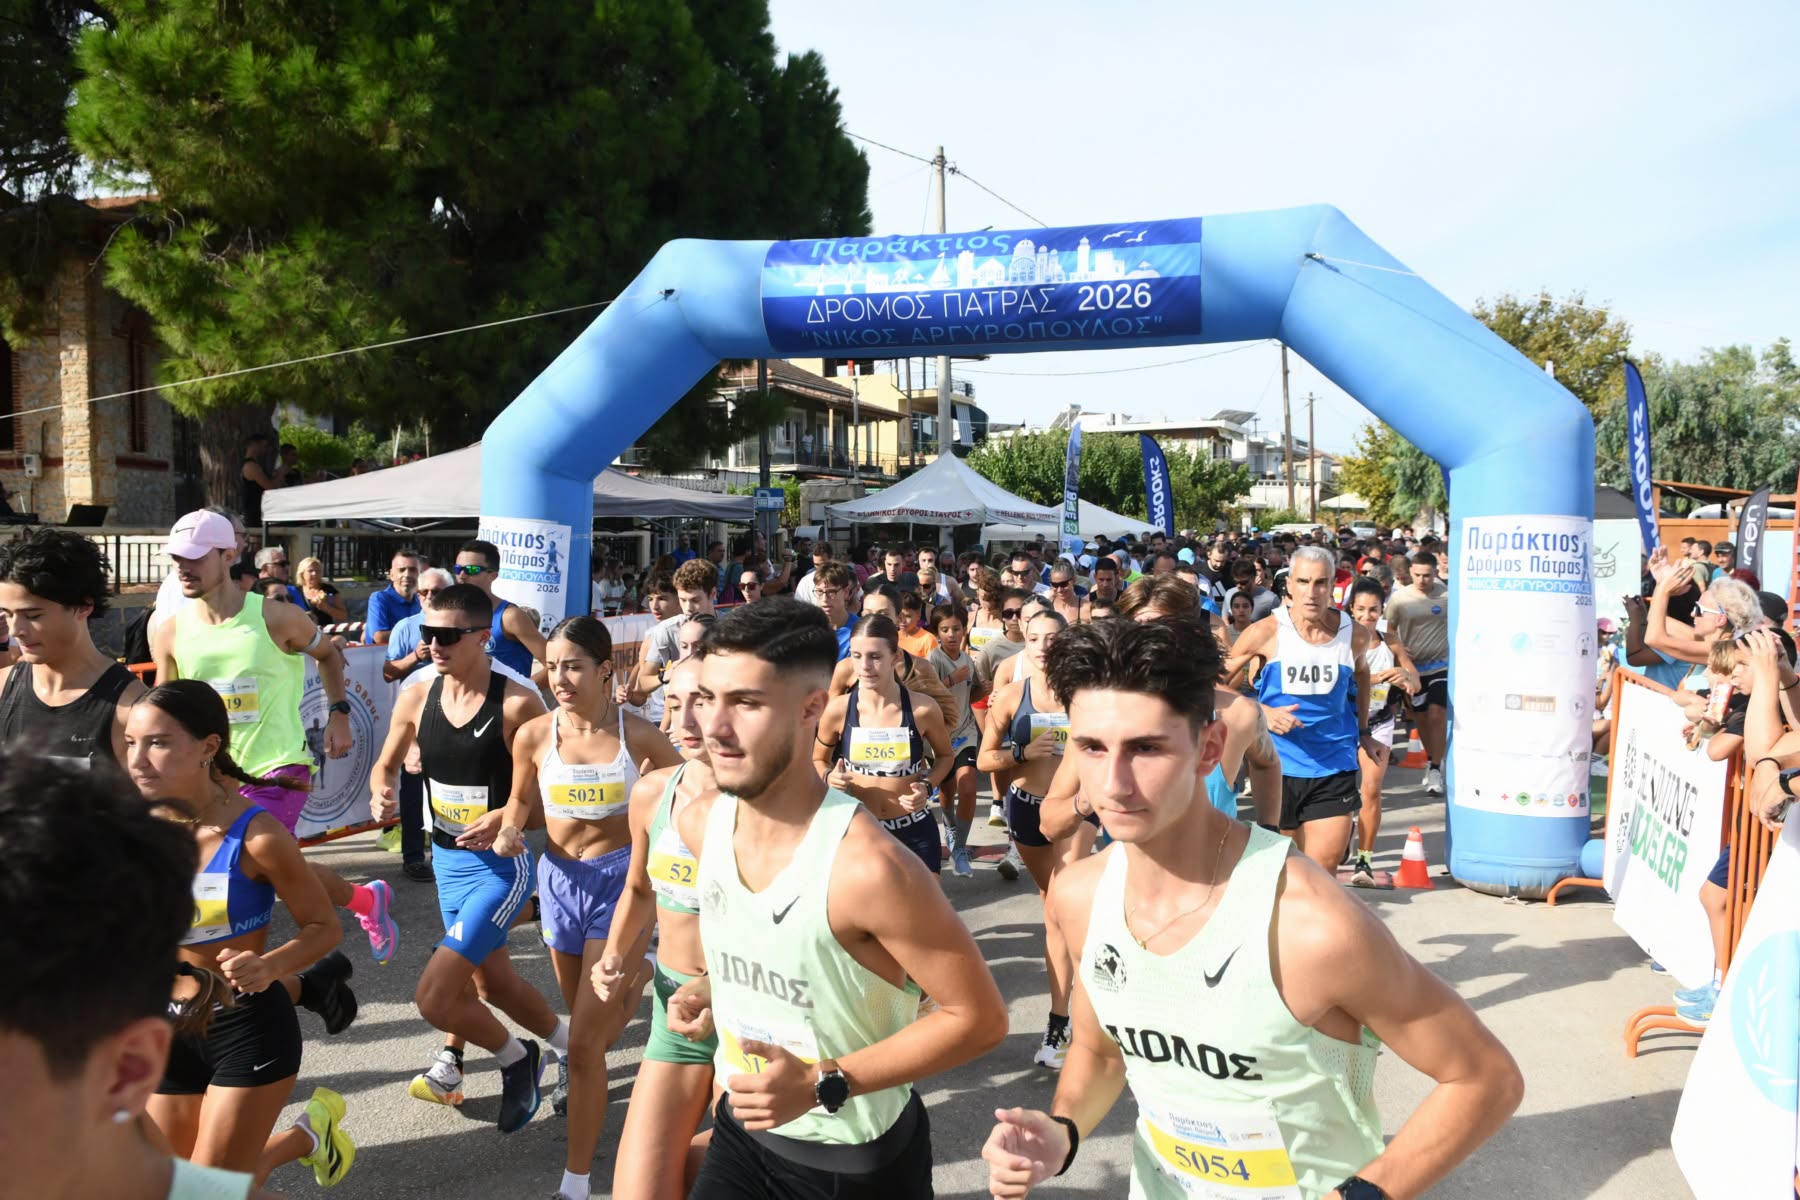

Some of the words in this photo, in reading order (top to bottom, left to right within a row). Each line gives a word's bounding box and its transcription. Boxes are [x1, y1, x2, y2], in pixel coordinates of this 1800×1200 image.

[811, 234, 1012, 260] Παράκτιος
[807, 294, 933, 324] ΔΡΟΜΟΣ
[943, 287, 1057, 319] ΠΑΤΡΑΣ
[1078, 282, 1152, 312] 2026
[1468, 526, 1579, 555] Παράκτιος
[502, 549, 545, 568] Πάτρας
[1467, 555, 1522, 575] Δρόμος
[1530, 555, 1581, 577] Πάτρας
[537, 584, 560, 593] 2026
[1287, 664, 1333, 684] 9405
[227, 697, 242, 709] 19
[1054, 730, 1068, 741] 20
[865, 747, 896, 758] 5265
[568, 788, 605, 803] 5021
[440, 804, 470, 821] 5087
[669, 862, 692, 883] 52
[234, 909, 270, 933] NIKE
[713, 951, 814, 1009] ΙΟΛΟΣ
[1175, 1145, 1250, 1181] 5054
